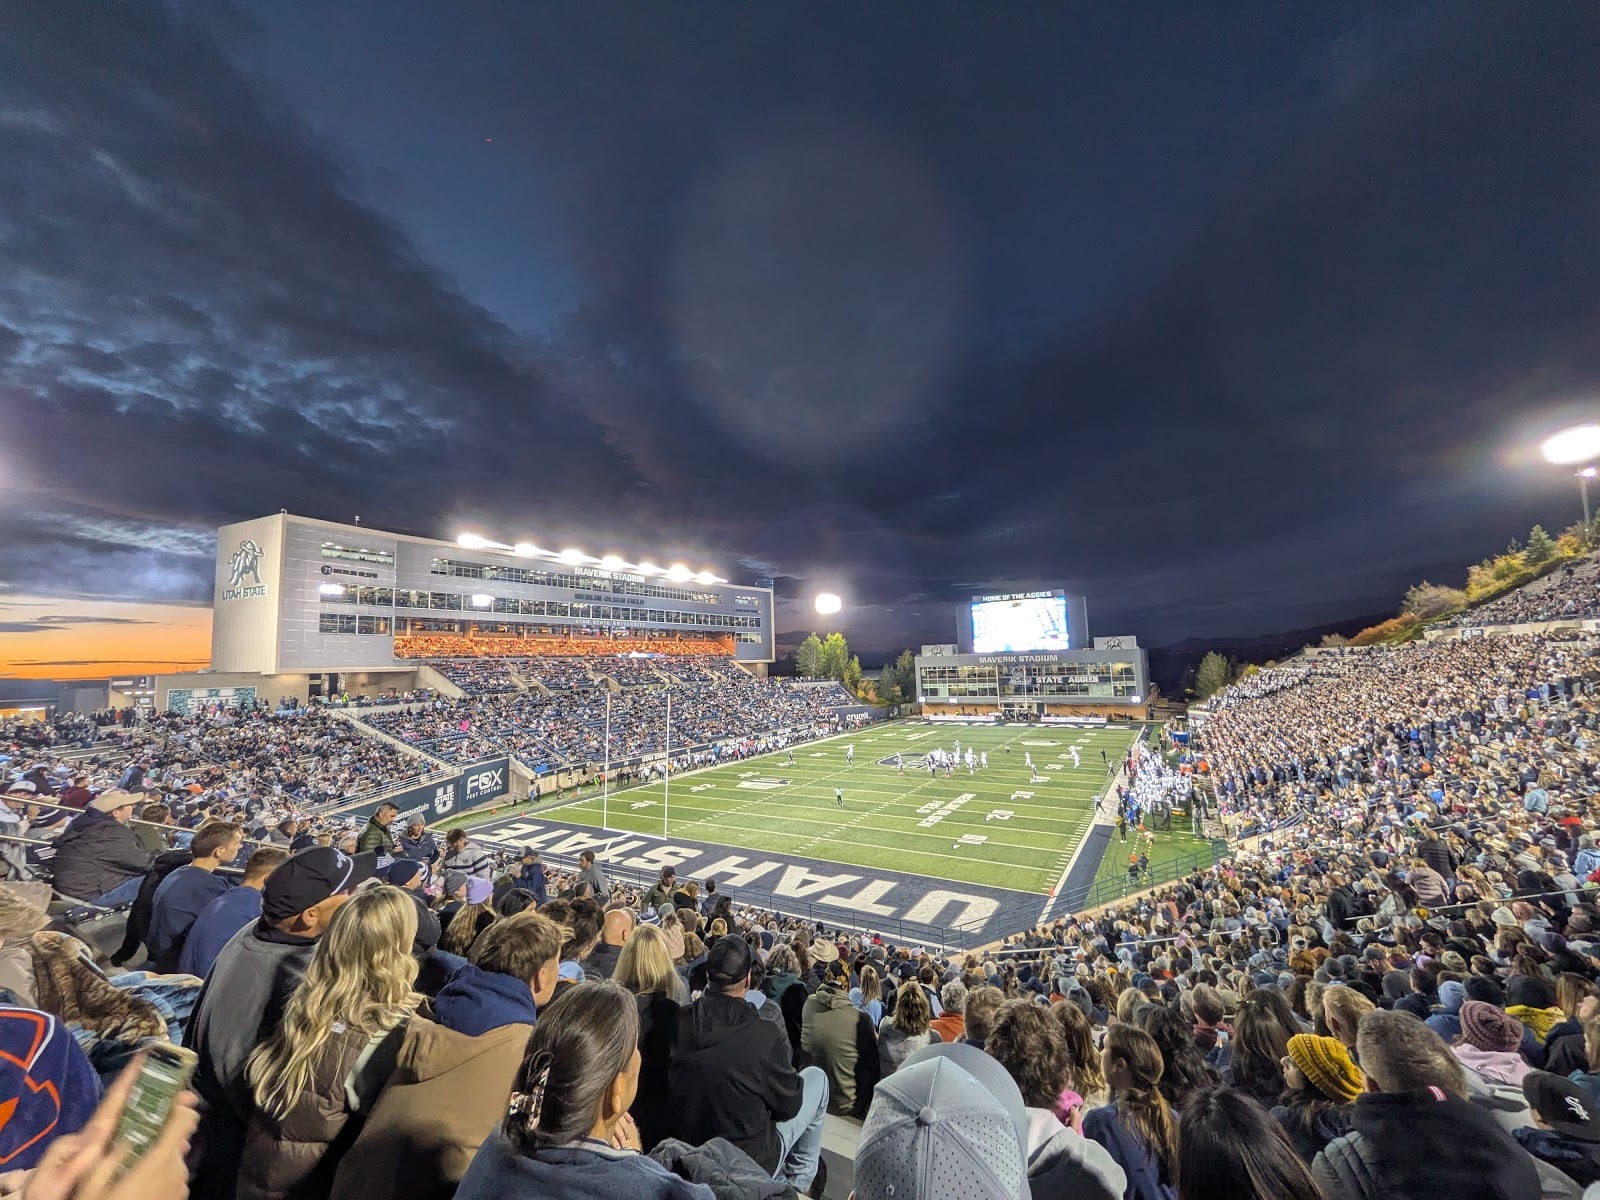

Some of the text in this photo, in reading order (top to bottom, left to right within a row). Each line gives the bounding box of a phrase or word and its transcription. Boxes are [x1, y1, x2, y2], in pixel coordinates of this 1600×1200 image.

[574, 567, 646, 583] MAVERIK STADIUM
[222, 585, 267, 600] UTAH STATE
[982, 594, 1002, 602] HOME
[1011, 592, 1025, 600] THE
[1025, 590, 1052, 599] AGGIES
[979, 654, 1058, 664] MAVERIK STADIUM
[1035, 676, 1064, 684] STATE
[1067, 675, 1099, 684] AGGIES
[466, 767, 503, 795] FOX
[434, 791, 456, 808] STATE
[467, 822, 705, 872] STATE
[687, 855, 1000, 935] UTAH
